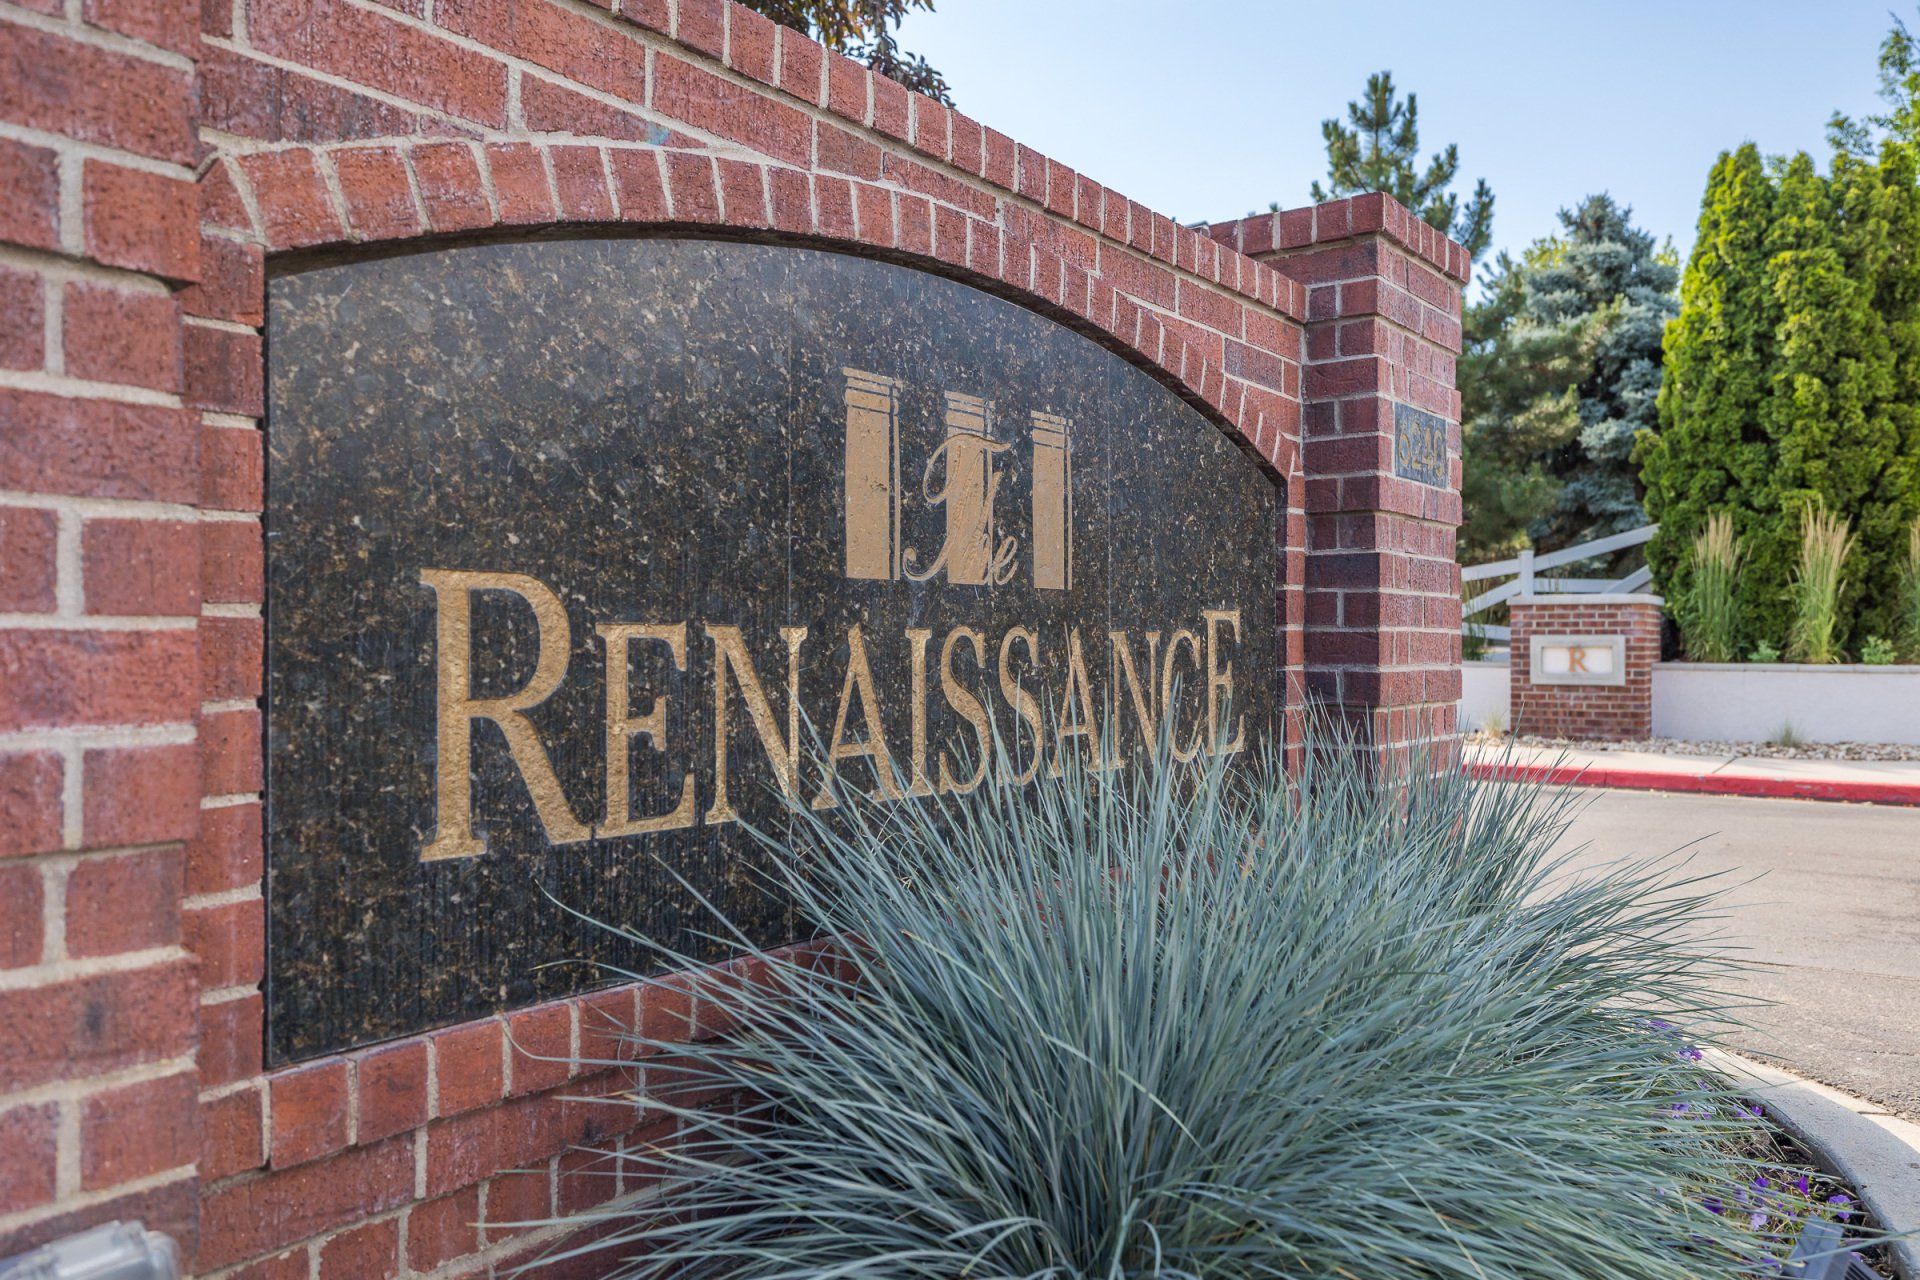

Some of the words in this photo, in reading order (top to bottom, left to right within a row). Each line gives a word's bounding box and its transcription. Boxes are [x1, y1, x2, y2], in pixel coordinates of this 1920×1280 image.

[902, 433, 1018, 586] The
[418, 568, 1245, 863] RENAISSANCE
[1568, 646, 1588, 673] R
